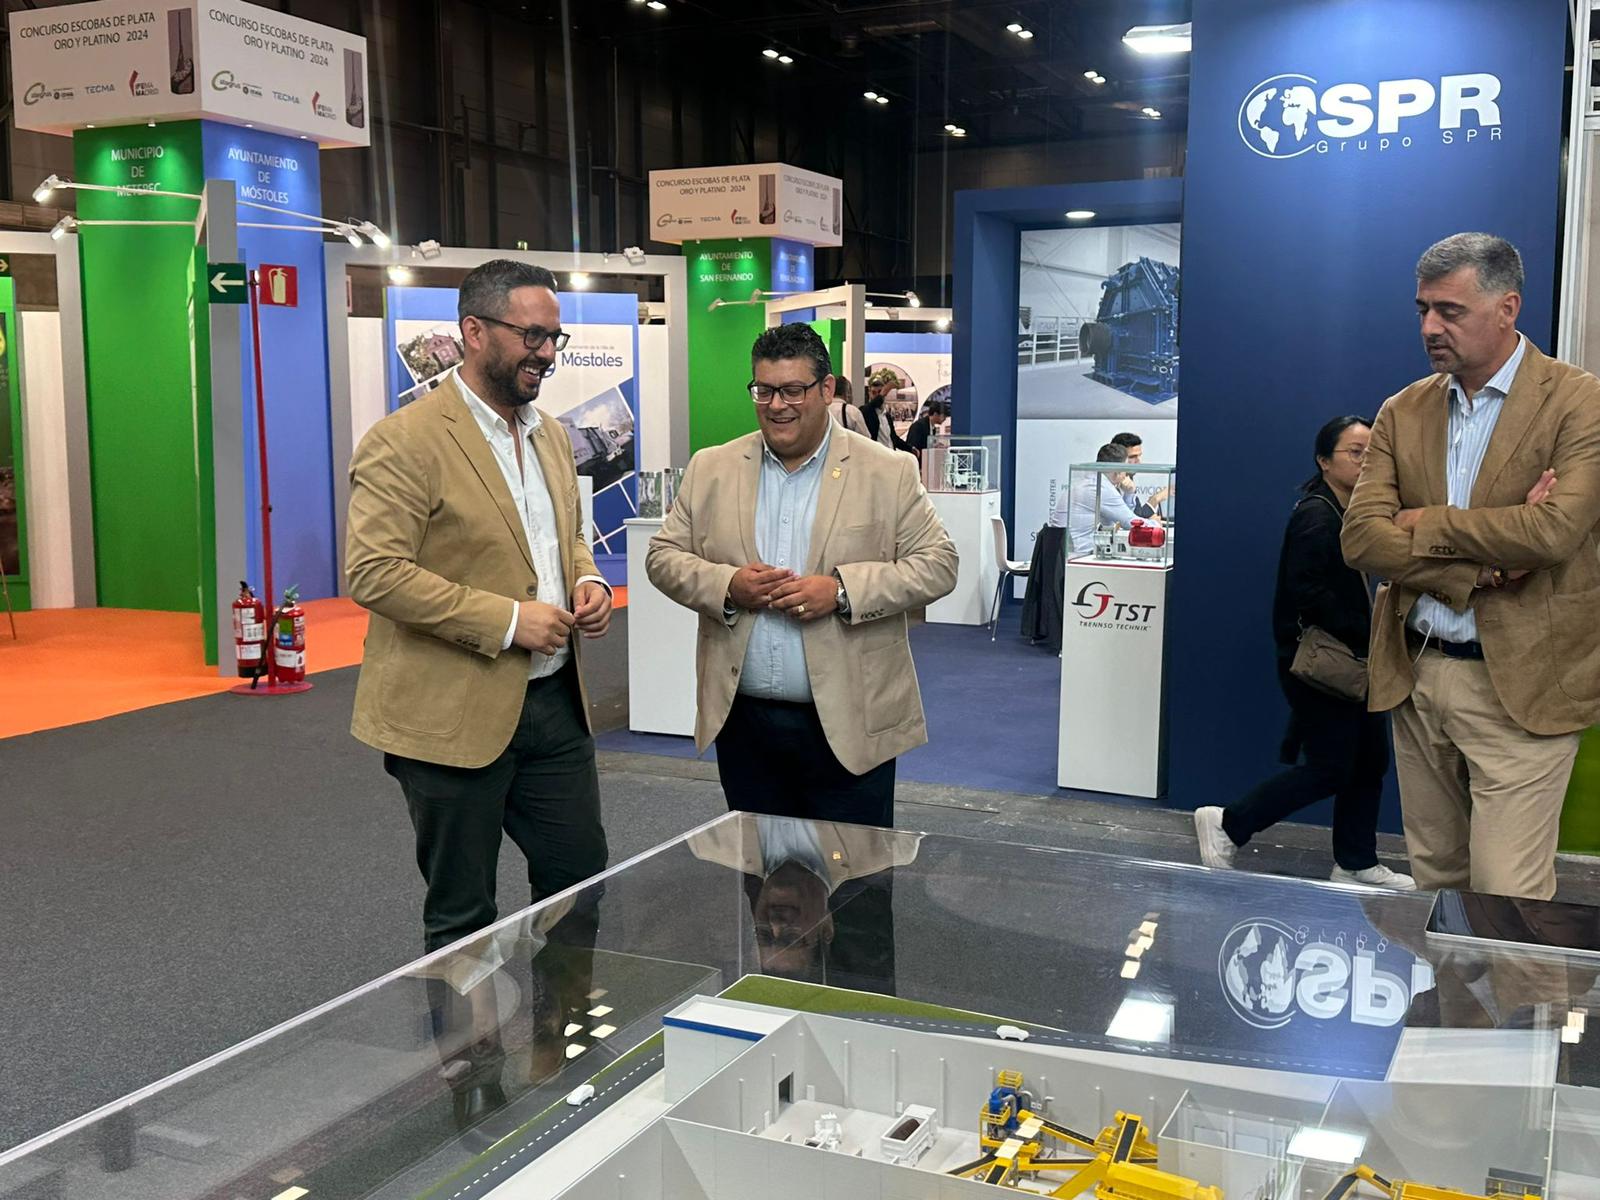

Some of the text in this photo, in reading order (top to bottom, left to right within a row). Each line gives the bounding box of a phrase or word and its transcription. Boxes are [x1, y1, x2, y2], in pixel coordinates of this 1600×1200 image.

[20, 12, 155, 38] CONCURSO ESCOBAS DE PLATA
[209, 9, 335, 54] CONCURSO ESCOBAS DE PLATA
[54, 29, 149, 50] ORO Y PLATINO 2024
[243, 34, 329, 67] ORO Y PLATINO 2024
[85, 83, 115, 94] TECMA
[272, 91, 300, 104] TECMA
[1316, 73, 1502, 138] SPR
[1316, 128, 1502, 153] Grupo SPR
[111, 145, 164, 162] MUNICIPIO
[227, 147, 298, 172] AYUNTAMIENTO
[131, 165, 145, 178] DE
[258, 170, 271, 184] DE
[656, 178, 691, 188] CONCURSO
[692, 176, 720, 185] ESCOBAS
[731, 174, 751, 183] PLATA
[240, 185, 289, 205] MÓSTOLES
[680, 188, 694, 196] ORO
[699, 186, 726, 194] PLATINO
[730, 184, 746, 192] 2024
[700, 251, 754, 260] AYUNTAMIENTO
[721, 262, 731, 271] DE
[700, 273, 754, 282] SAN FERNANDO
[561, 352, 623, 367] Móstoles
[1114, 602, 1156, 623] TST
[1080, 621, 1148, 632] TRENNSO TECHNIK
